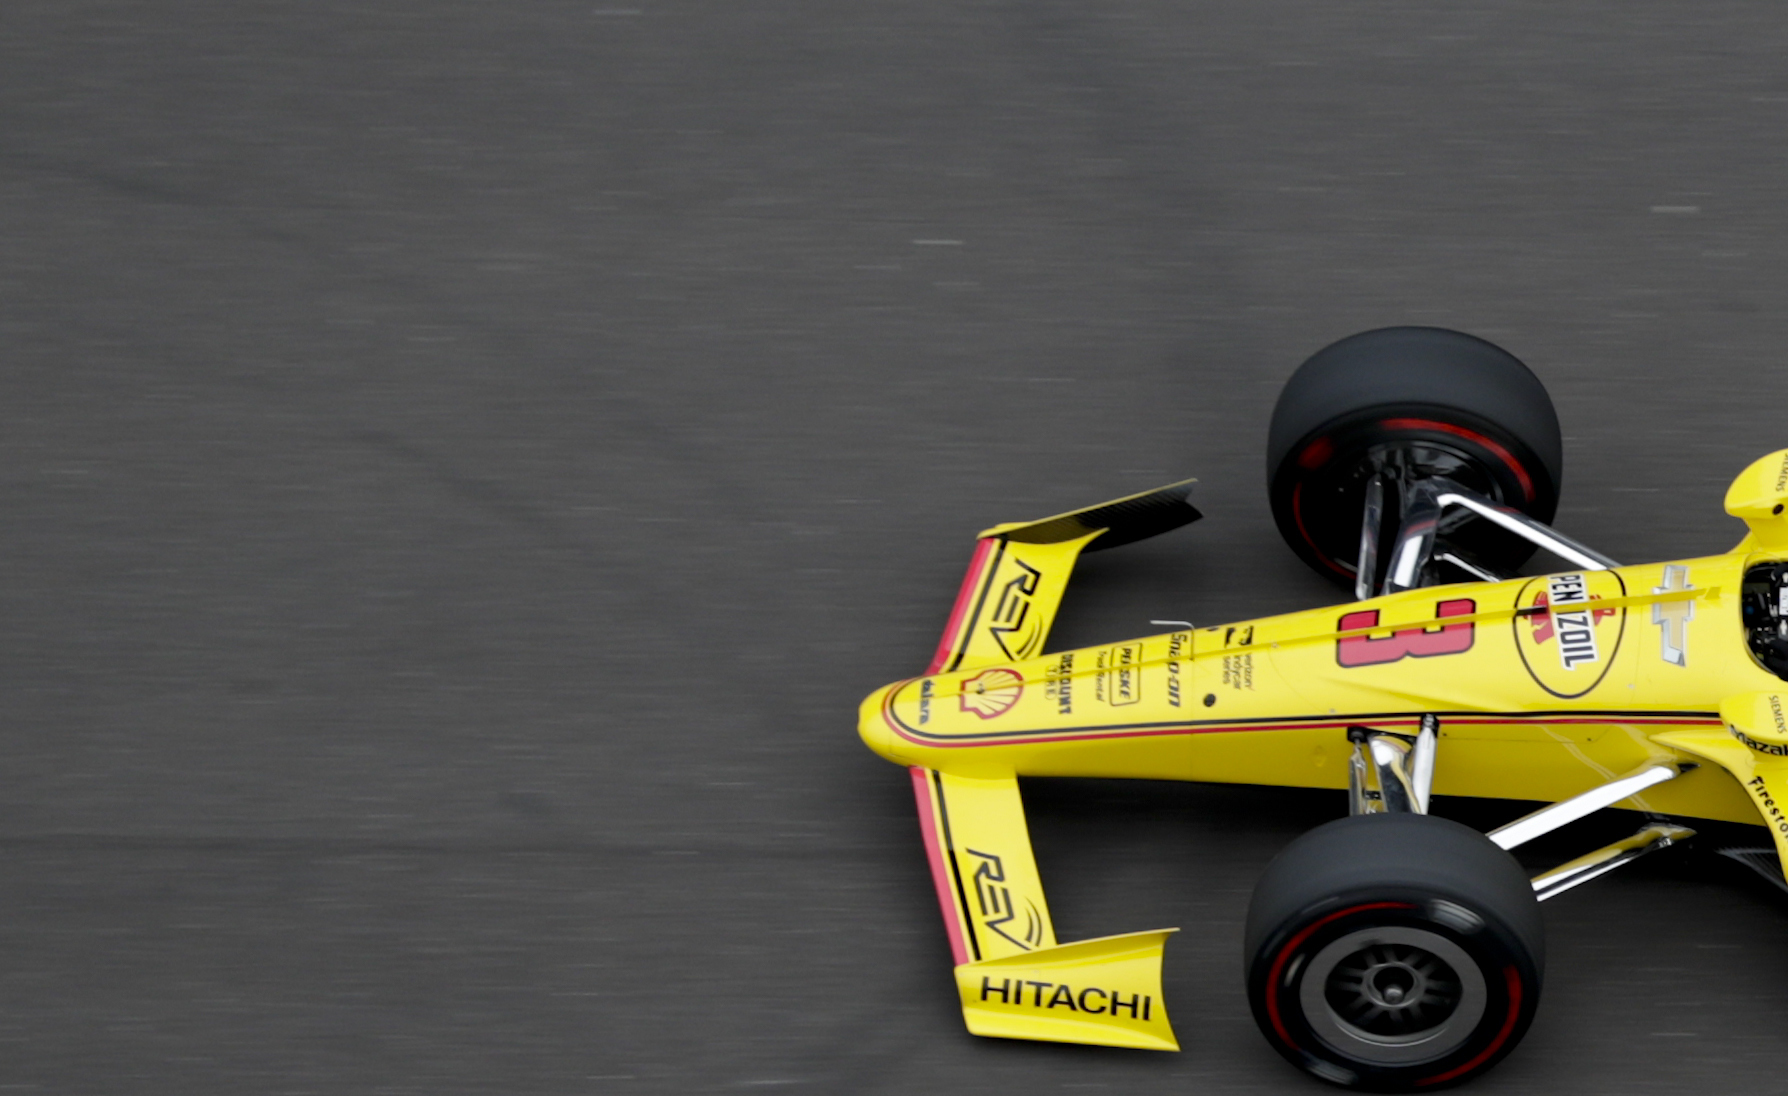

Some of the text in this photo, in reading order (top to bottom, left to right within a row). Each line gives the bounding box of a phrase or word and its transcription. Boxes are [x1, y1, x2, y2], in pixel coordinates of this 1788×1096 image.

[989, 557, 1042, 661] REV
[1336, 598, 1476, 668] 3
[1550, 575, 1595, 668] PENZOIL
[1769, 694, 1788, 734] SIEMENS
[965, 847, 1033, 951] REV
[979, 976, 1153, 1021] HITACHI
